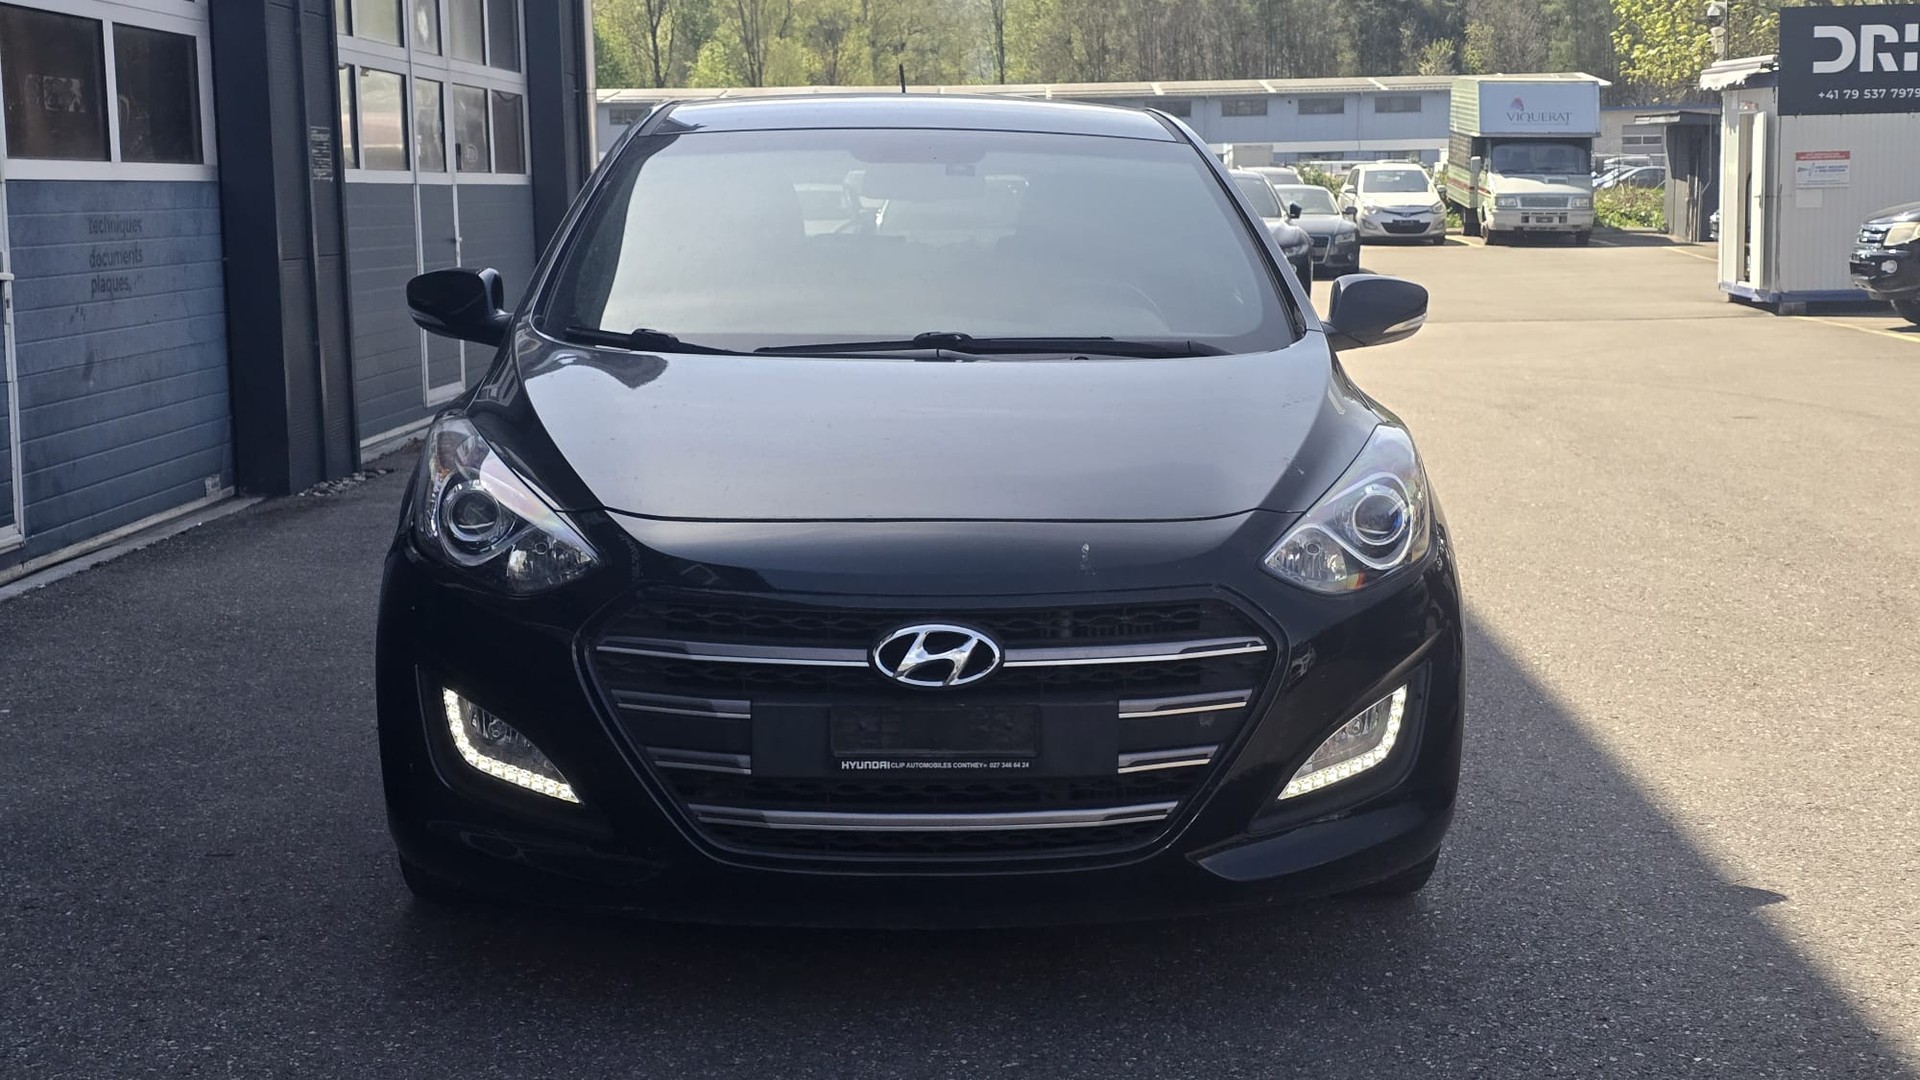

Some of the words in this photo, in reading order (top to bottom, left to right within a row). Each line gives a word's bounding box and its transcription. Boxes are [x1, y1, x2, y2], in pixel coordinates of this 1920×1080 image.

[1818, 89, 1839, 100] +41
[1843, 89, 1859, 99] 79
[1863, 88, 1886, 99] 537
[1506, 112, 1572, 124] VIQUERAT
[88, 214, 143, 238] techniques
[89, 242, 143, 268] documents
[841, 761, 890, 769] HYUNDAI
